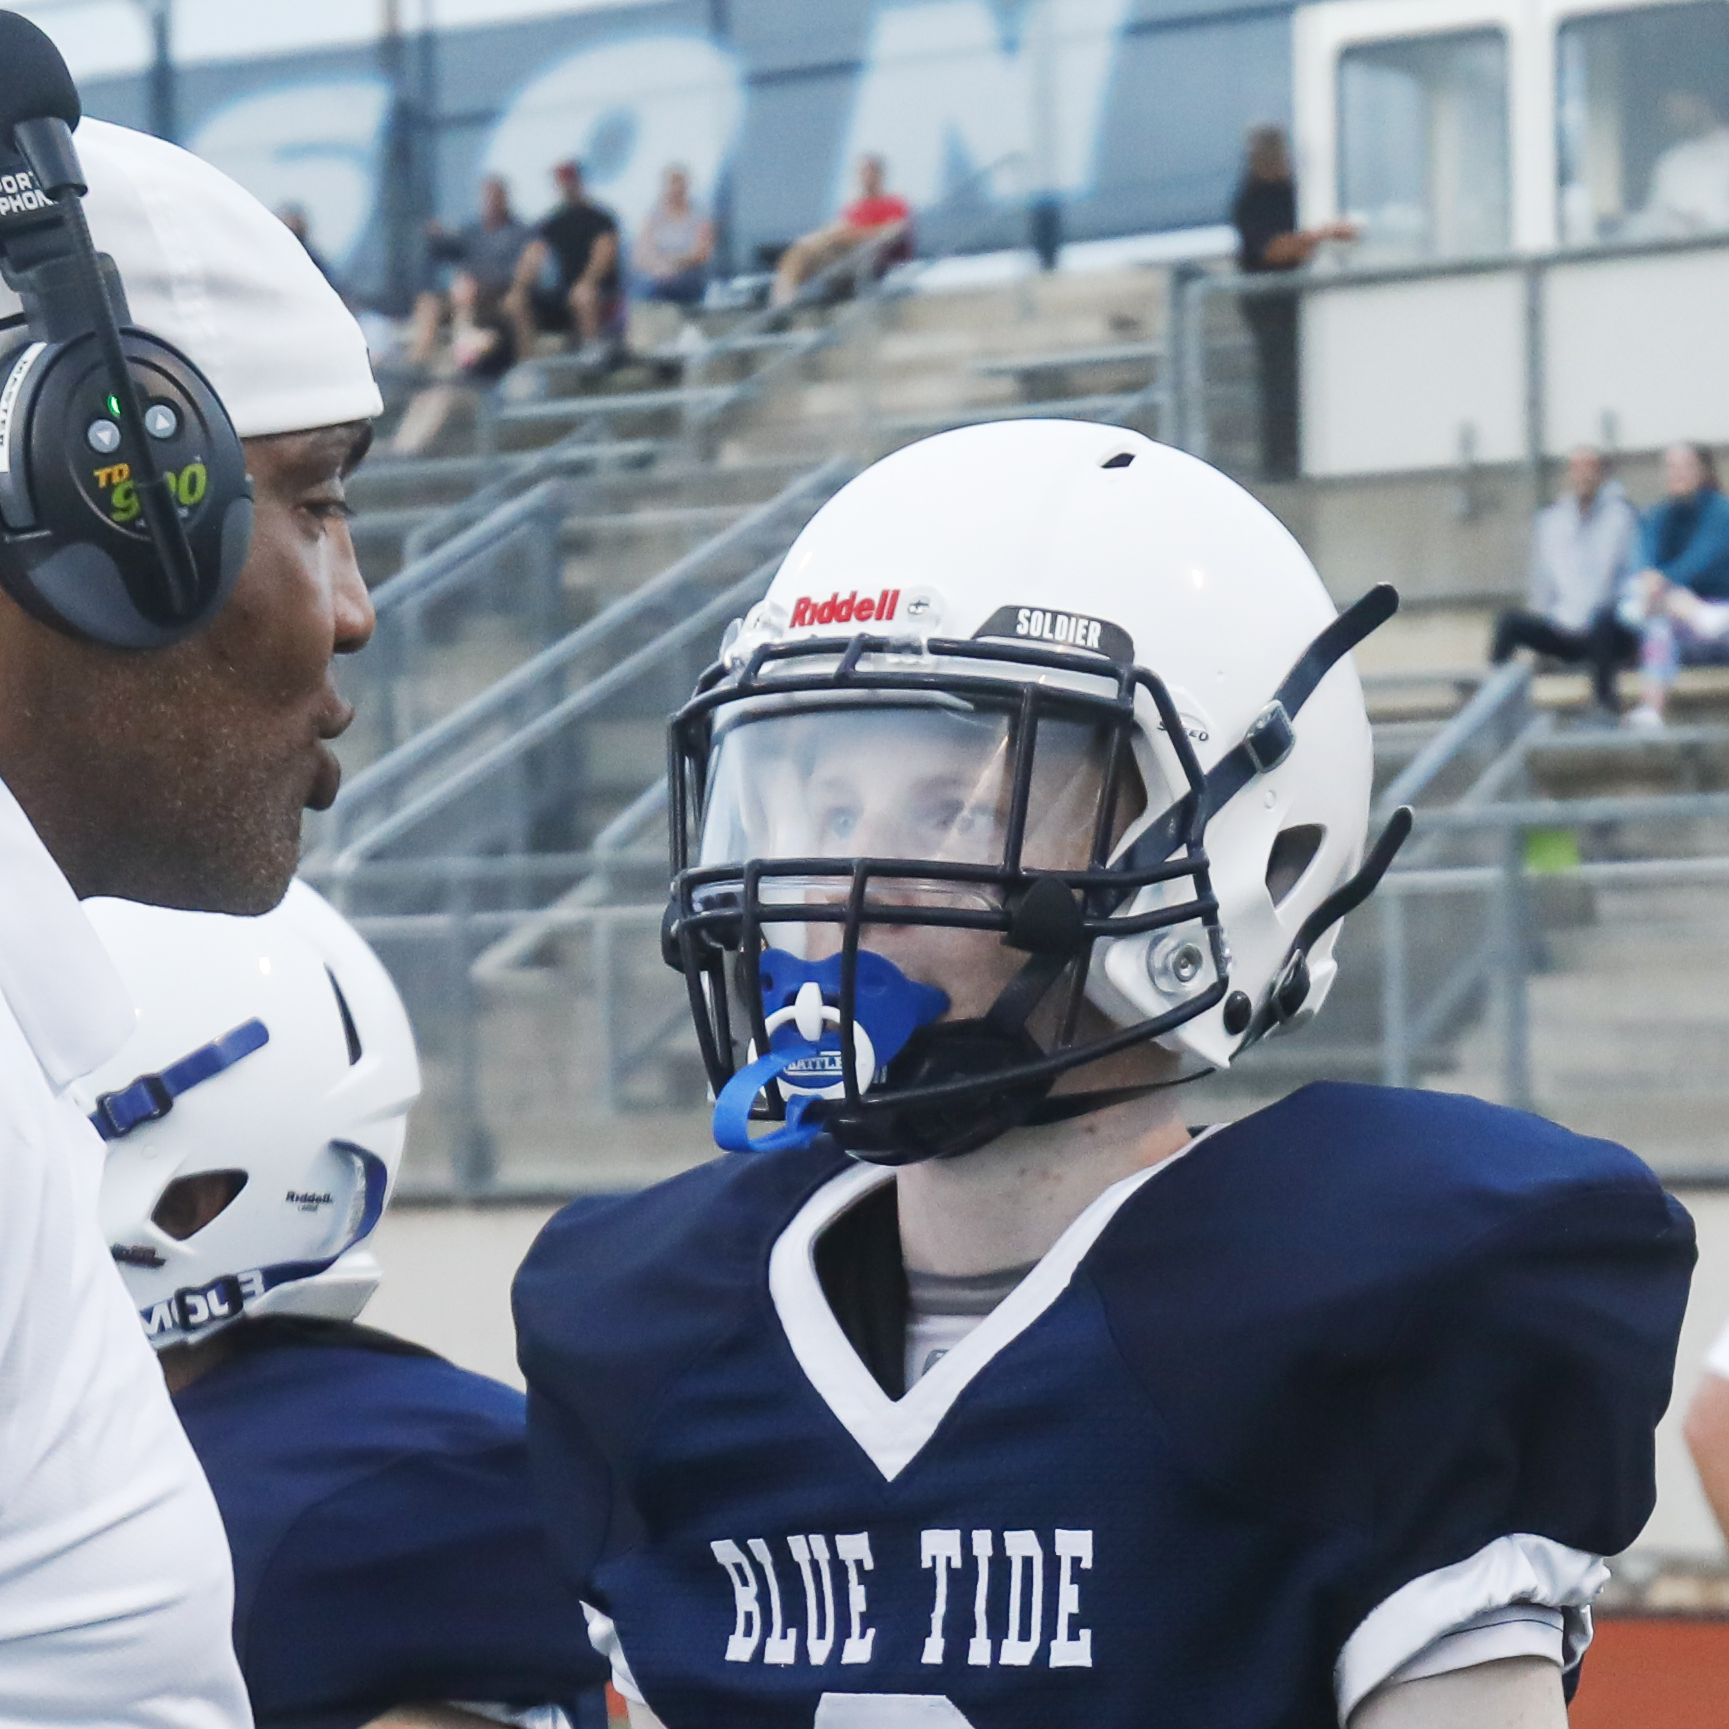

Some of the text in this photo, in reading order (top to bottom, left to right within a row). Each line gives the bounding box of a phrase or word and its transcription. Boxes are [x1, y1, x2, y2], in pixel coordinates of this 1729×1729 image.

[93, 463, 130, 488] TD
[789, 589, 900, 629] Riddell
[1016, 608, 1102, 649] SOLDIER
[710, 1529, 1094, 1668] BLUE TIDE
